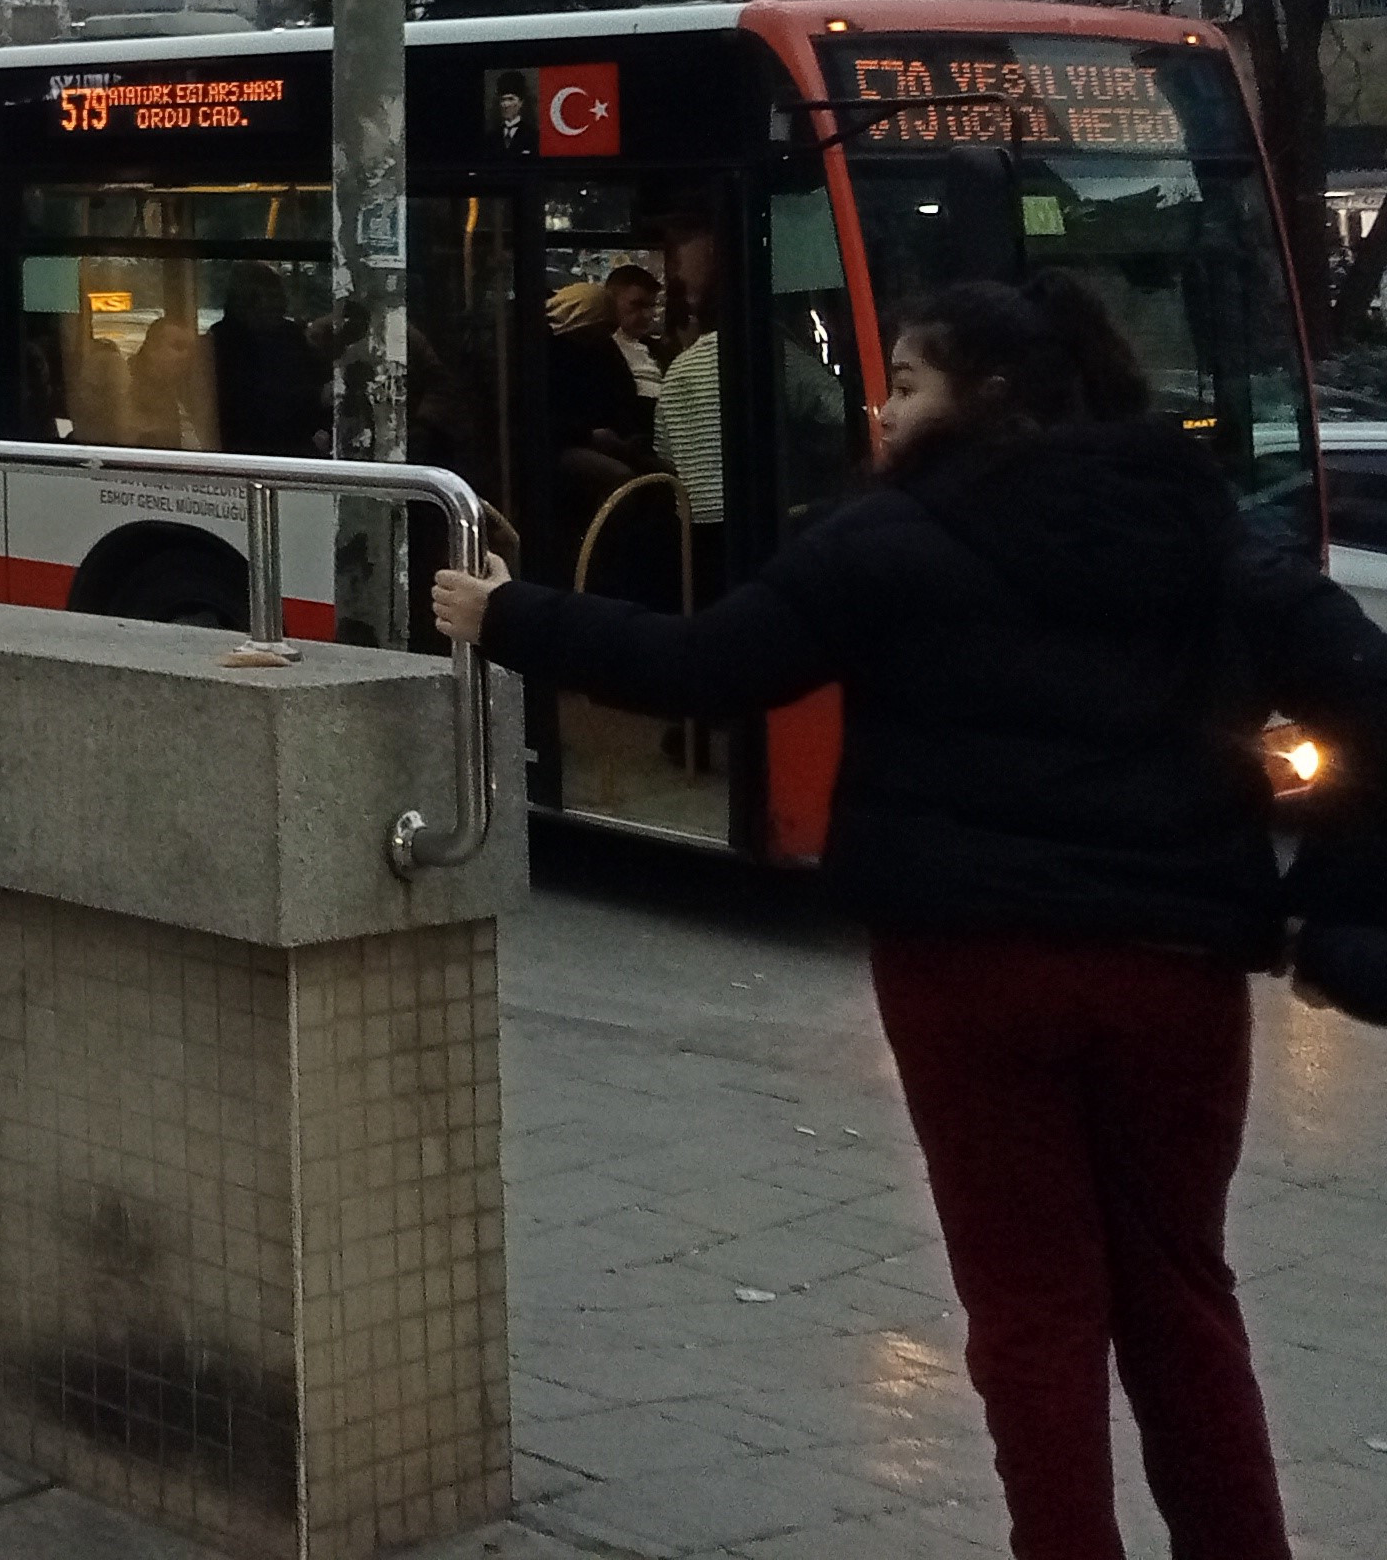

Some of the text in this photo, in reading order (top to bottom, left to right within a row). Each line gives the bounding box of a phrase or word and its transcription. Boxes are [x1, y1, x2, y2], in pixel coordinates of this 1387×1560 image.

[61, 88, 108, 130] 579
[136, 105, 249, 129] ORDU CAD.
[100, 489, 134, 507] ESHOT
[137, 493, 173, 513] GENEL
